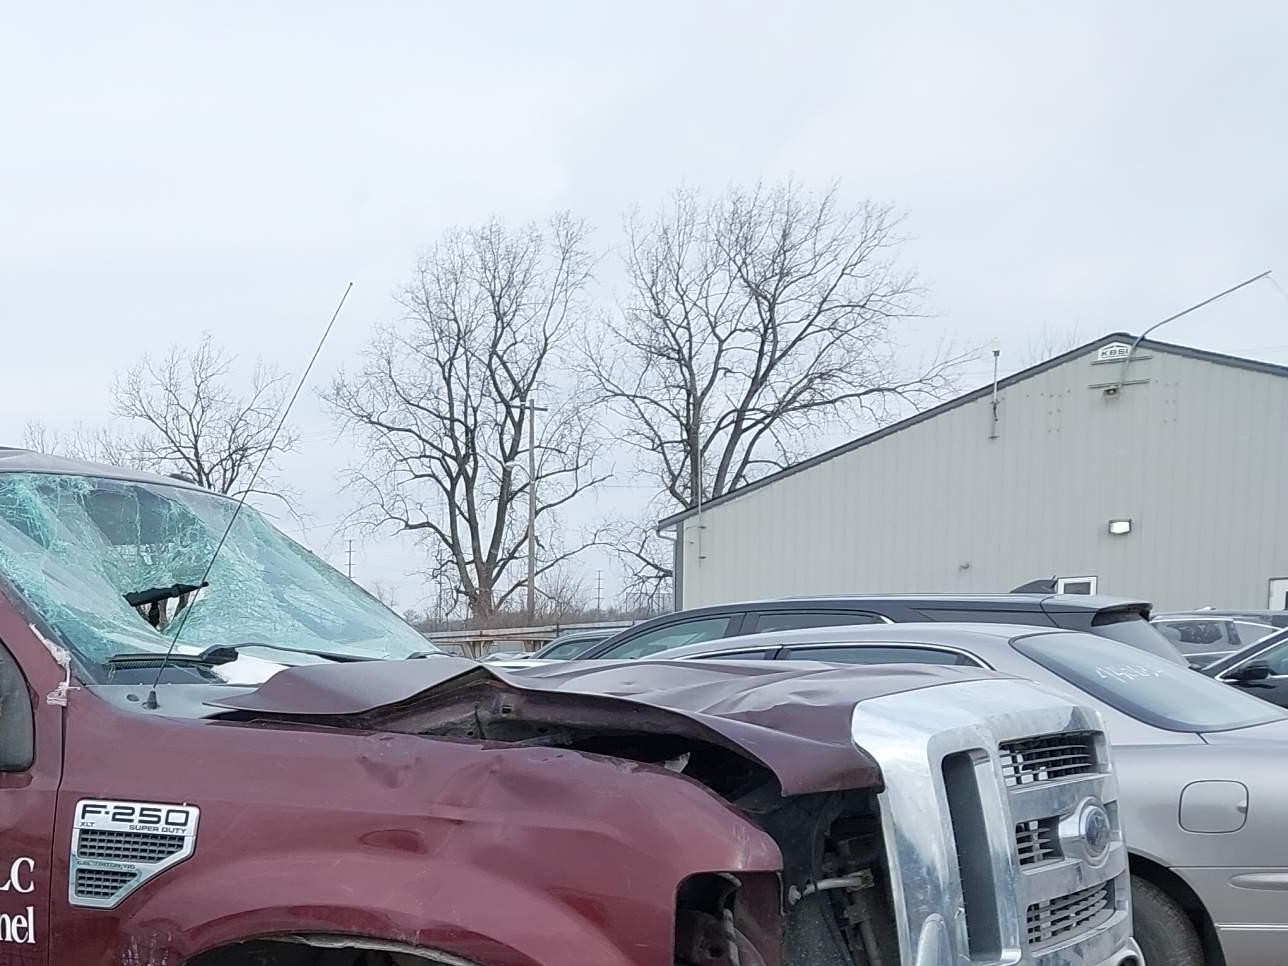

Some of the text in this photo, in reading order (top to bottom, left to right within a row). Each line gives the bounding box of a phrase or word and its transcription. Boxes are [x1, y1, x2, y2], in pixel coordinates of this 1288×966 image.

[81, 803, 190, 827] F-250
[128, 824, 187, 835] SUPER DUTY
